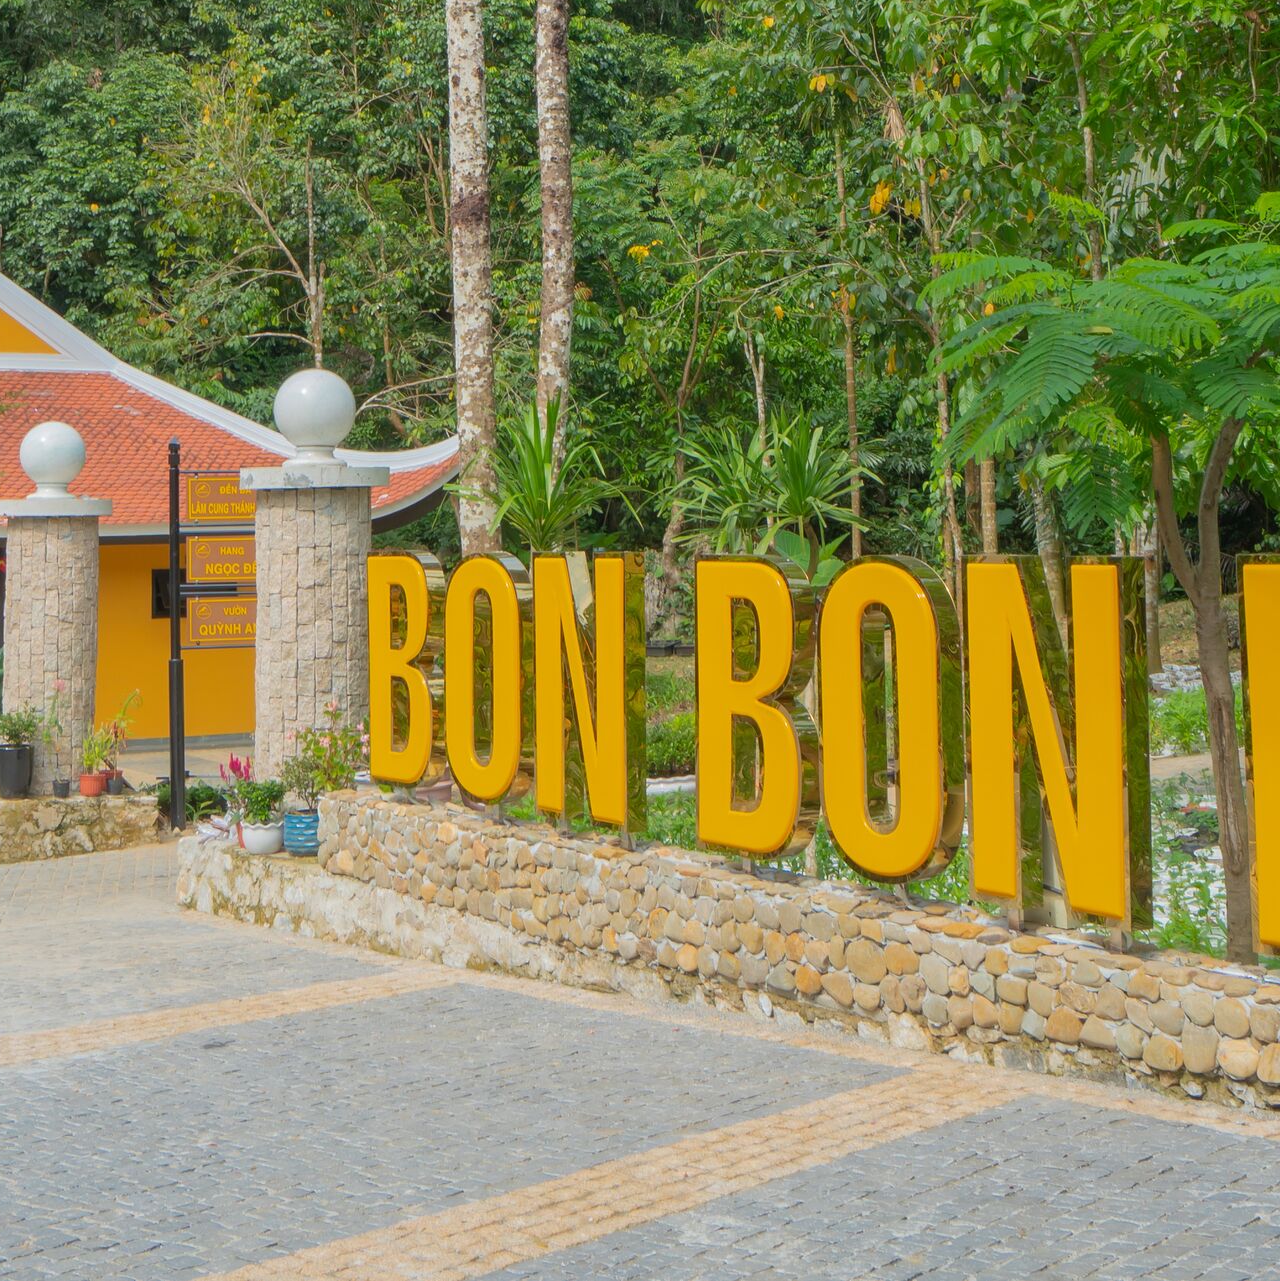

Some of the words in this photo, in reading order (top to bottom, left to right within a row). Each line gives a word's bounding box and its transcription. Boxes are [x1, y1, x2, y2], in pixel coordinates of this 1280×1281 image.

[208, 503, 229, 514] CUNG
[230, 500, 256, 514] THÁNH
[220, 546, 244, 555] HANG
[205, 563, 240, 577] NGỌC
[199, 621, 241, 636] QUỲNH
[367, 553, 629, 827] BON
[696, 559, 1125, 921] BON
